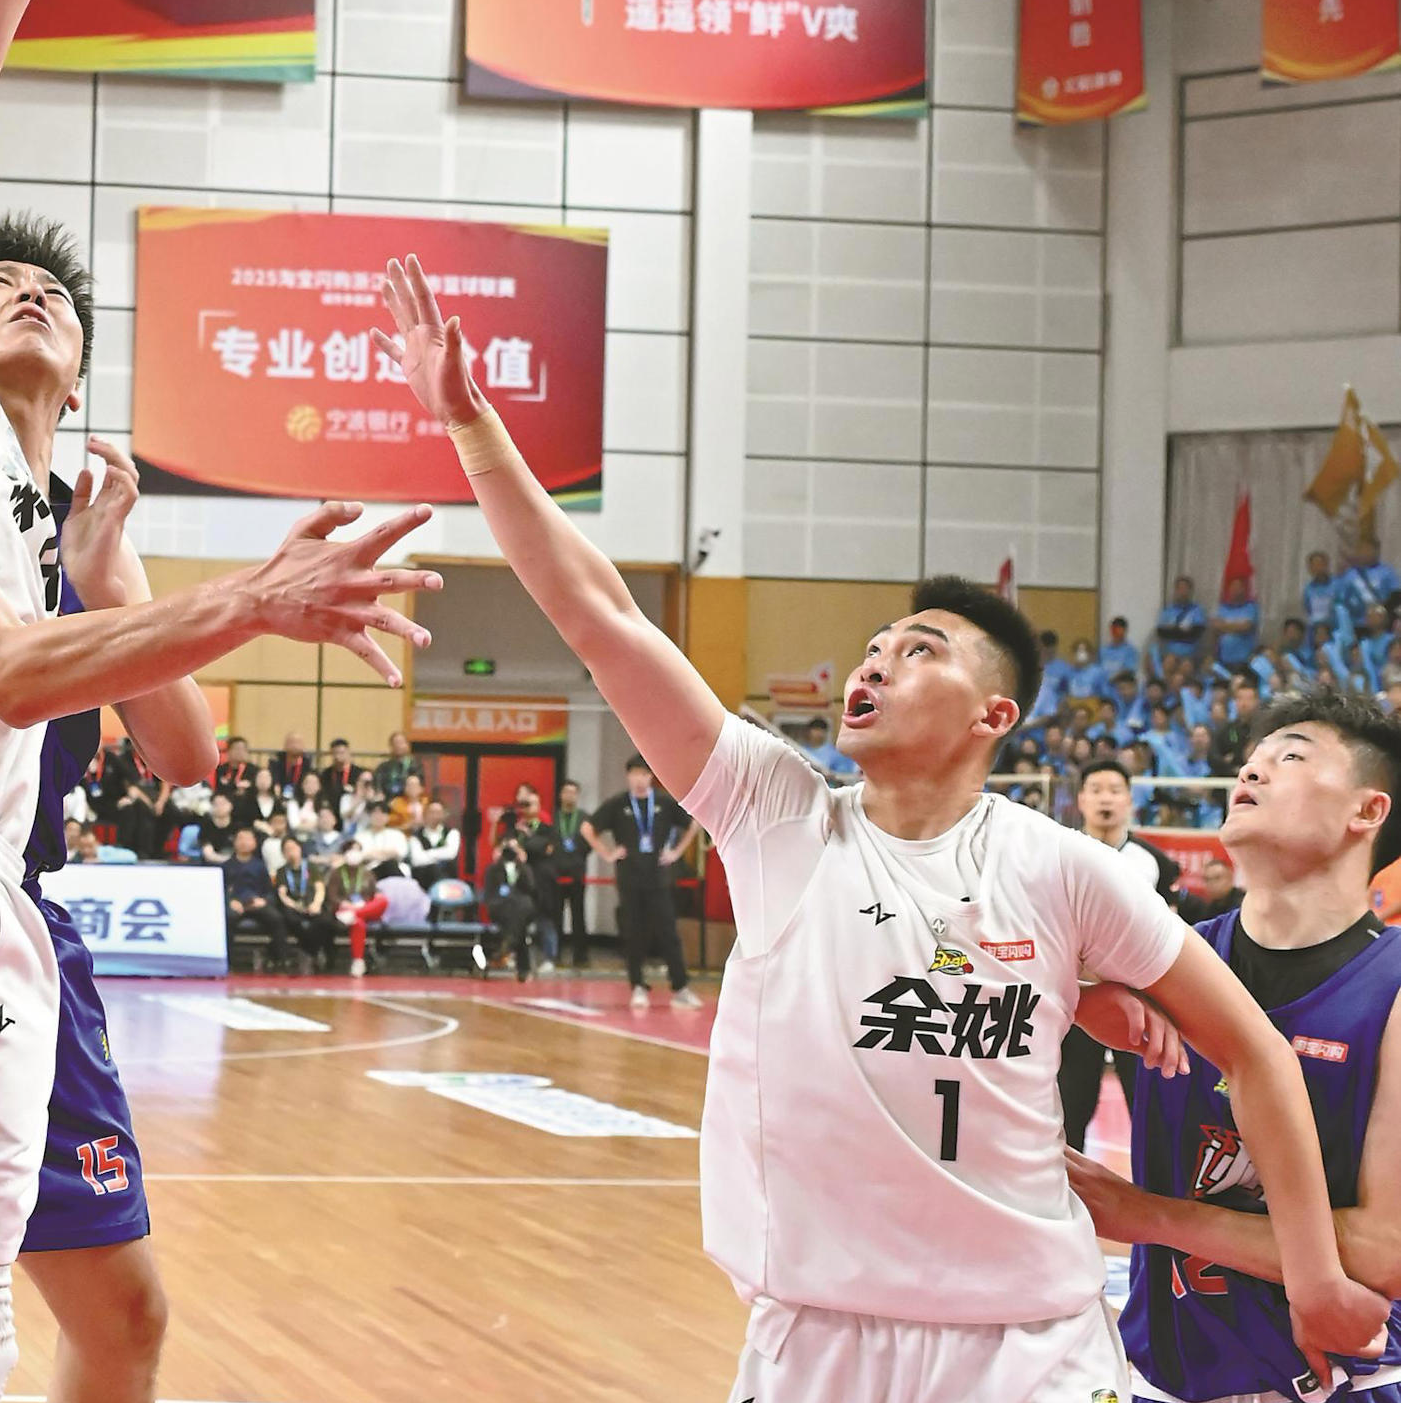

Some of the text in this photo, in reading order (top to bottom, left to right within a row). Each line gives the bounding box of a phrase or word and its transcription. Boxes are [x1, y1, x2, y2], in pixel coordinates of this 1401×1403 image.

[65, 898, 171, 942] 商会
[853, 975, 1042, 1059] 余姚
[934, 1079, 961, 1161] 1
[77, 1135, 129, 1195] 15
